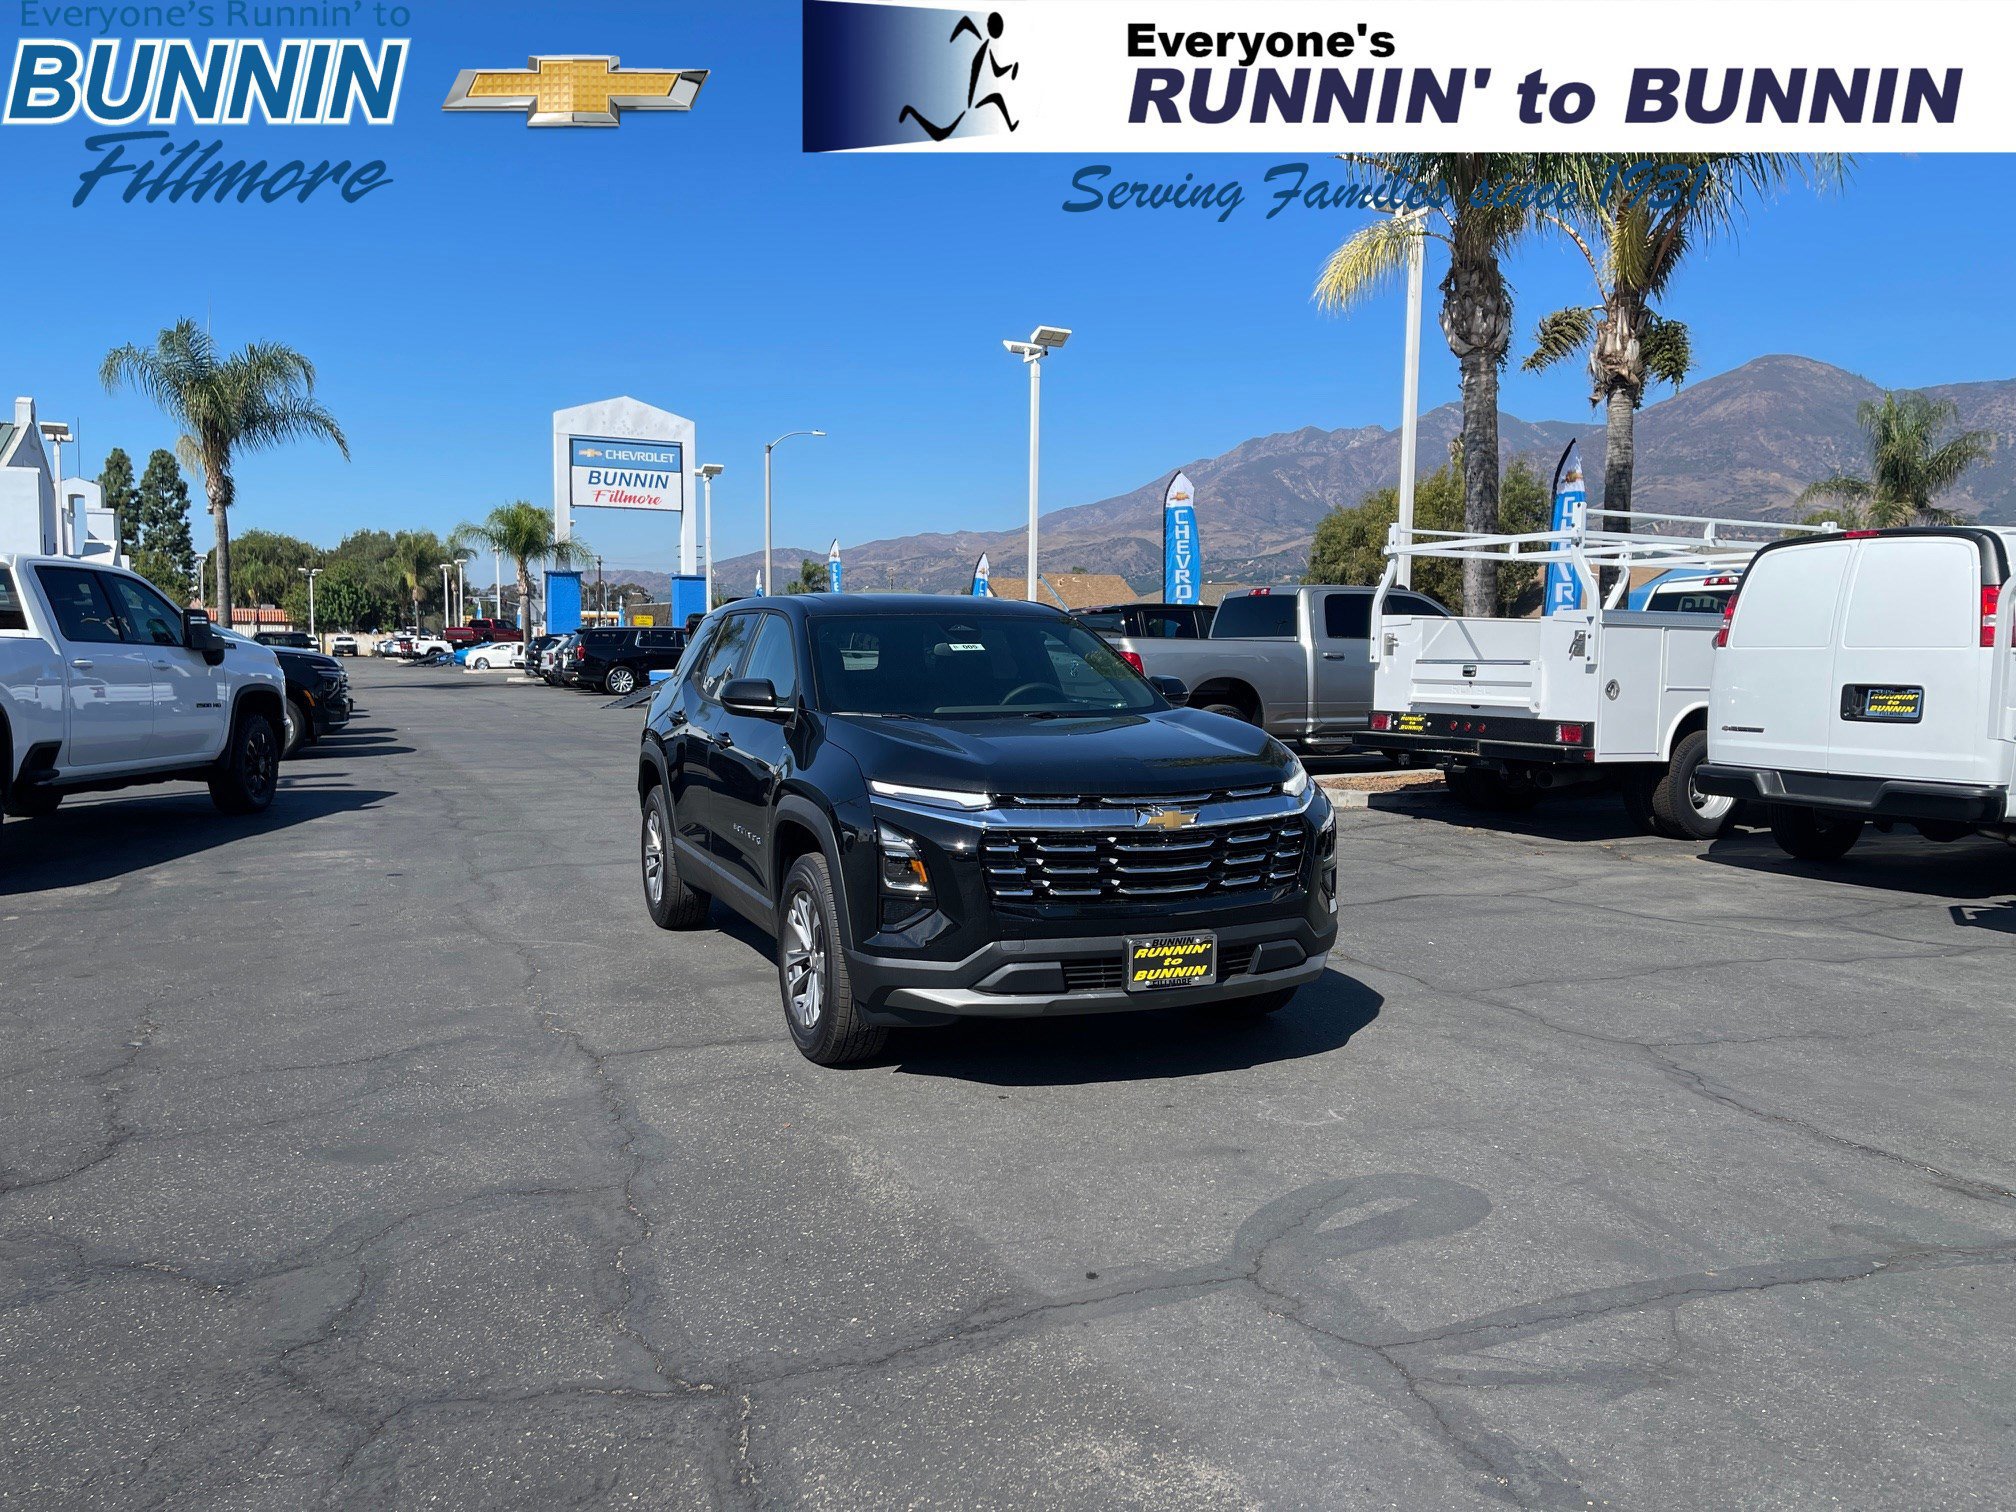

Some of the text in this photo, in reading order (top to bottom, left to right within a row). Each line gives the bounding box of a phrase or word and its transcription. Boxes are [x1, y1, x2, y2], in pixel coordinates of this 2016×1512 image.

[605, 449, 675, 464] CHEVROLET
[588, 470, 670, 490] BUNNIN
[593, 489, 663, 506] Fillmore
[1869, 704, 1916, 713] BUNNIN
[1152, 936, 1195, 947] BUNNIN
[1134, 943, 1212, 959] RUNNIN'
[1163, 957, 1183, 966] to
[1133, 964, 1208, 982] BUNNIN
